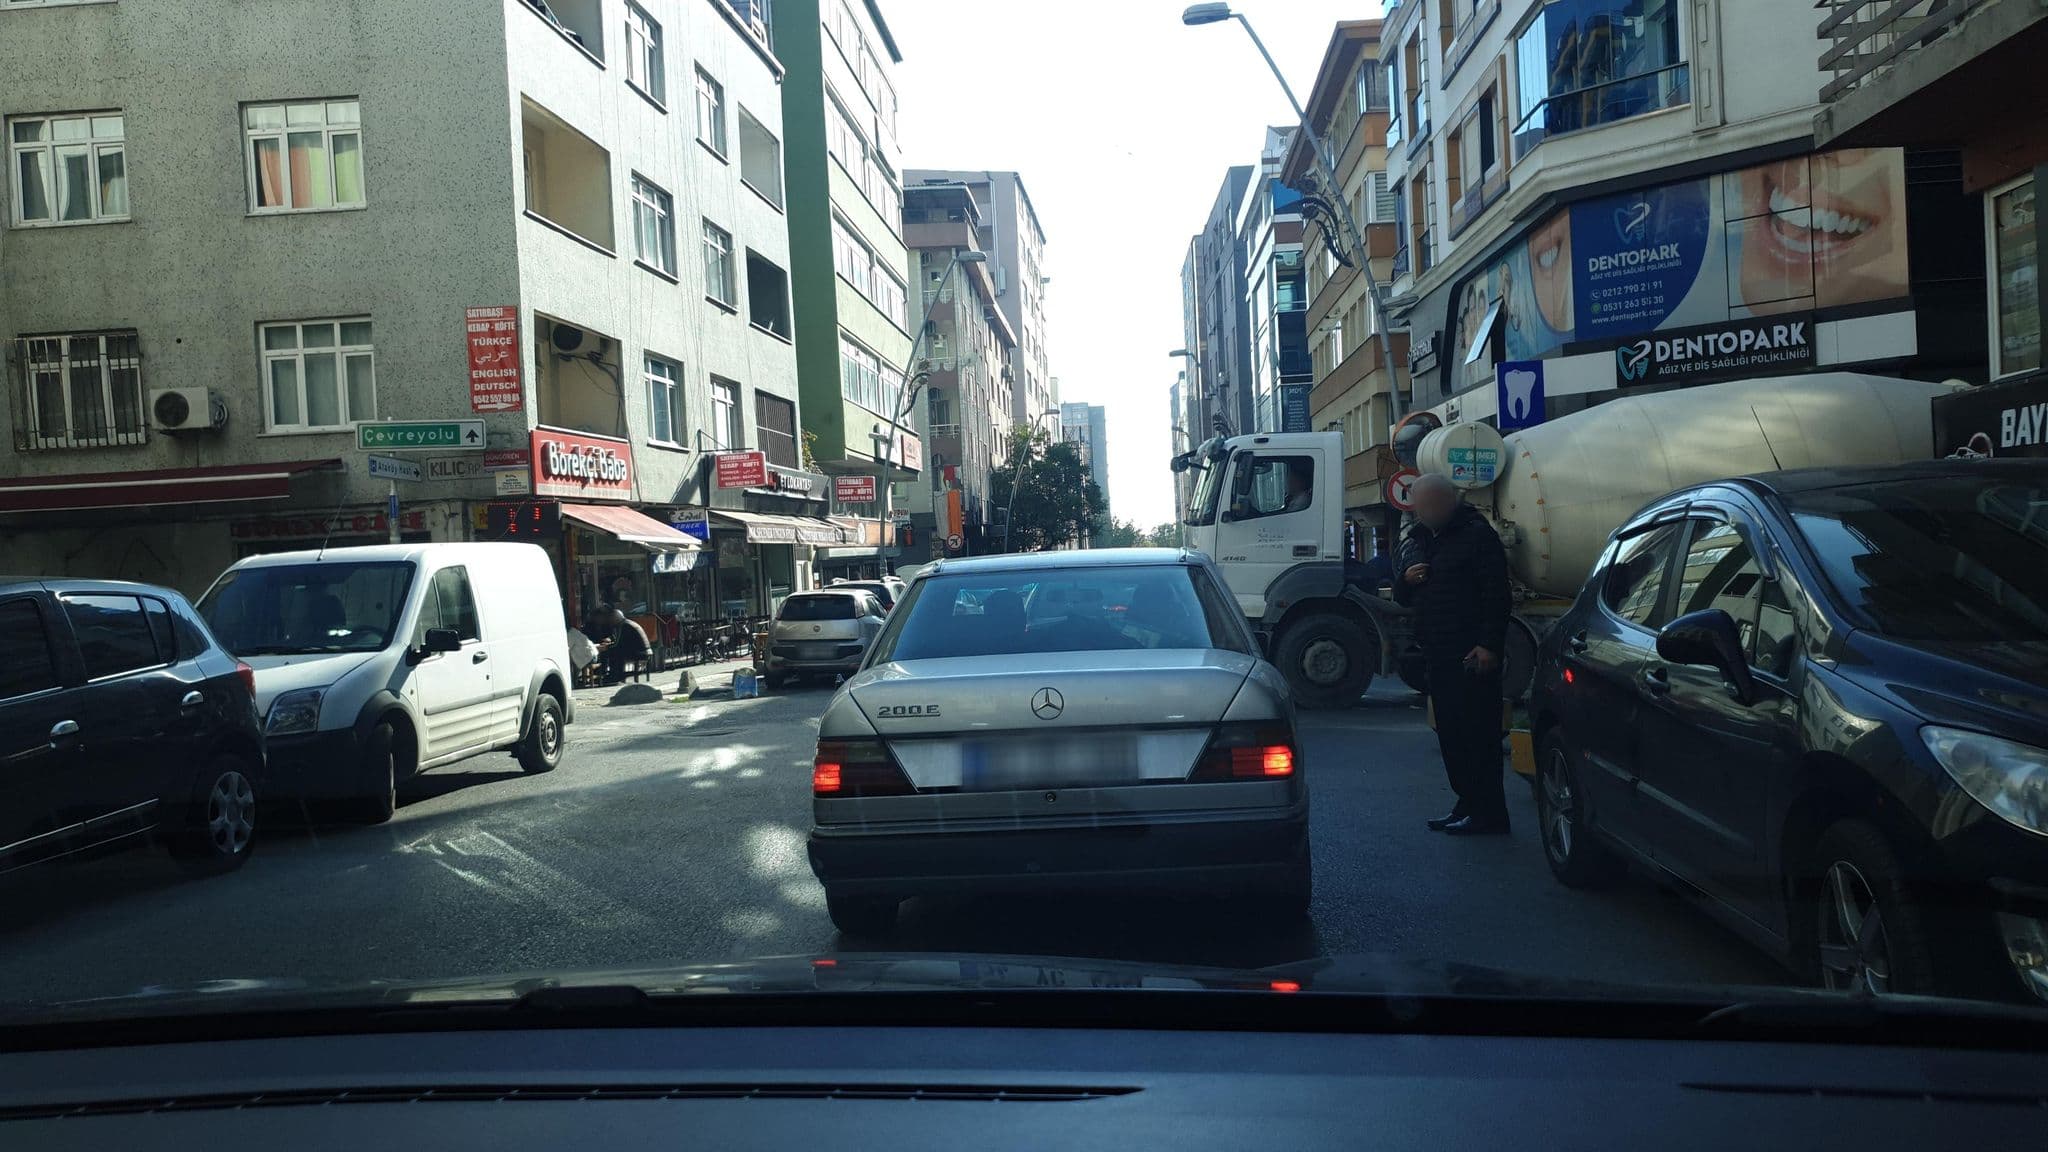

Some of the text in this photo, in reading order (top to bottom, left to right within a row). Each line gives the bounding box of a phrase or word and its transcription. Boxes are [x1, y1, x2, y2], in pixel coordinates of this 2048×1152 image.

[1588, 243, 1680, 272] DENTOPARK
[1602, 280, 1663, 298] 0212 790 21 91
[1603, 301, 1622, 312] 0531
[1624, 298, 1640, 309] 263
[1653, 295, 1664, 304] 30
[1591, 309, 1664, 324] www.dentopark.com
[473, 337, 512, 346] TÜRKÇE
[1655, 321, 1806, 362] DENTOPARK
[475, 351, 509, 364] عربي
[1658, 348, 1810, 375] AĞIZ VE DİŞ SAĞLIĞI POLİKLİNİĞİ
[472, 368, 516, 378] ENGLISH
[474, 382, 516, 391] DEUTSCH
[2001, 402, 2048, 448] BAY
[364, 428, 454, 444] Çevreyolu
[549, 440, 598, 484] Börekçi
[599, 447, 627, 481] Baba
[878, 704, 940, 716] 200 E
